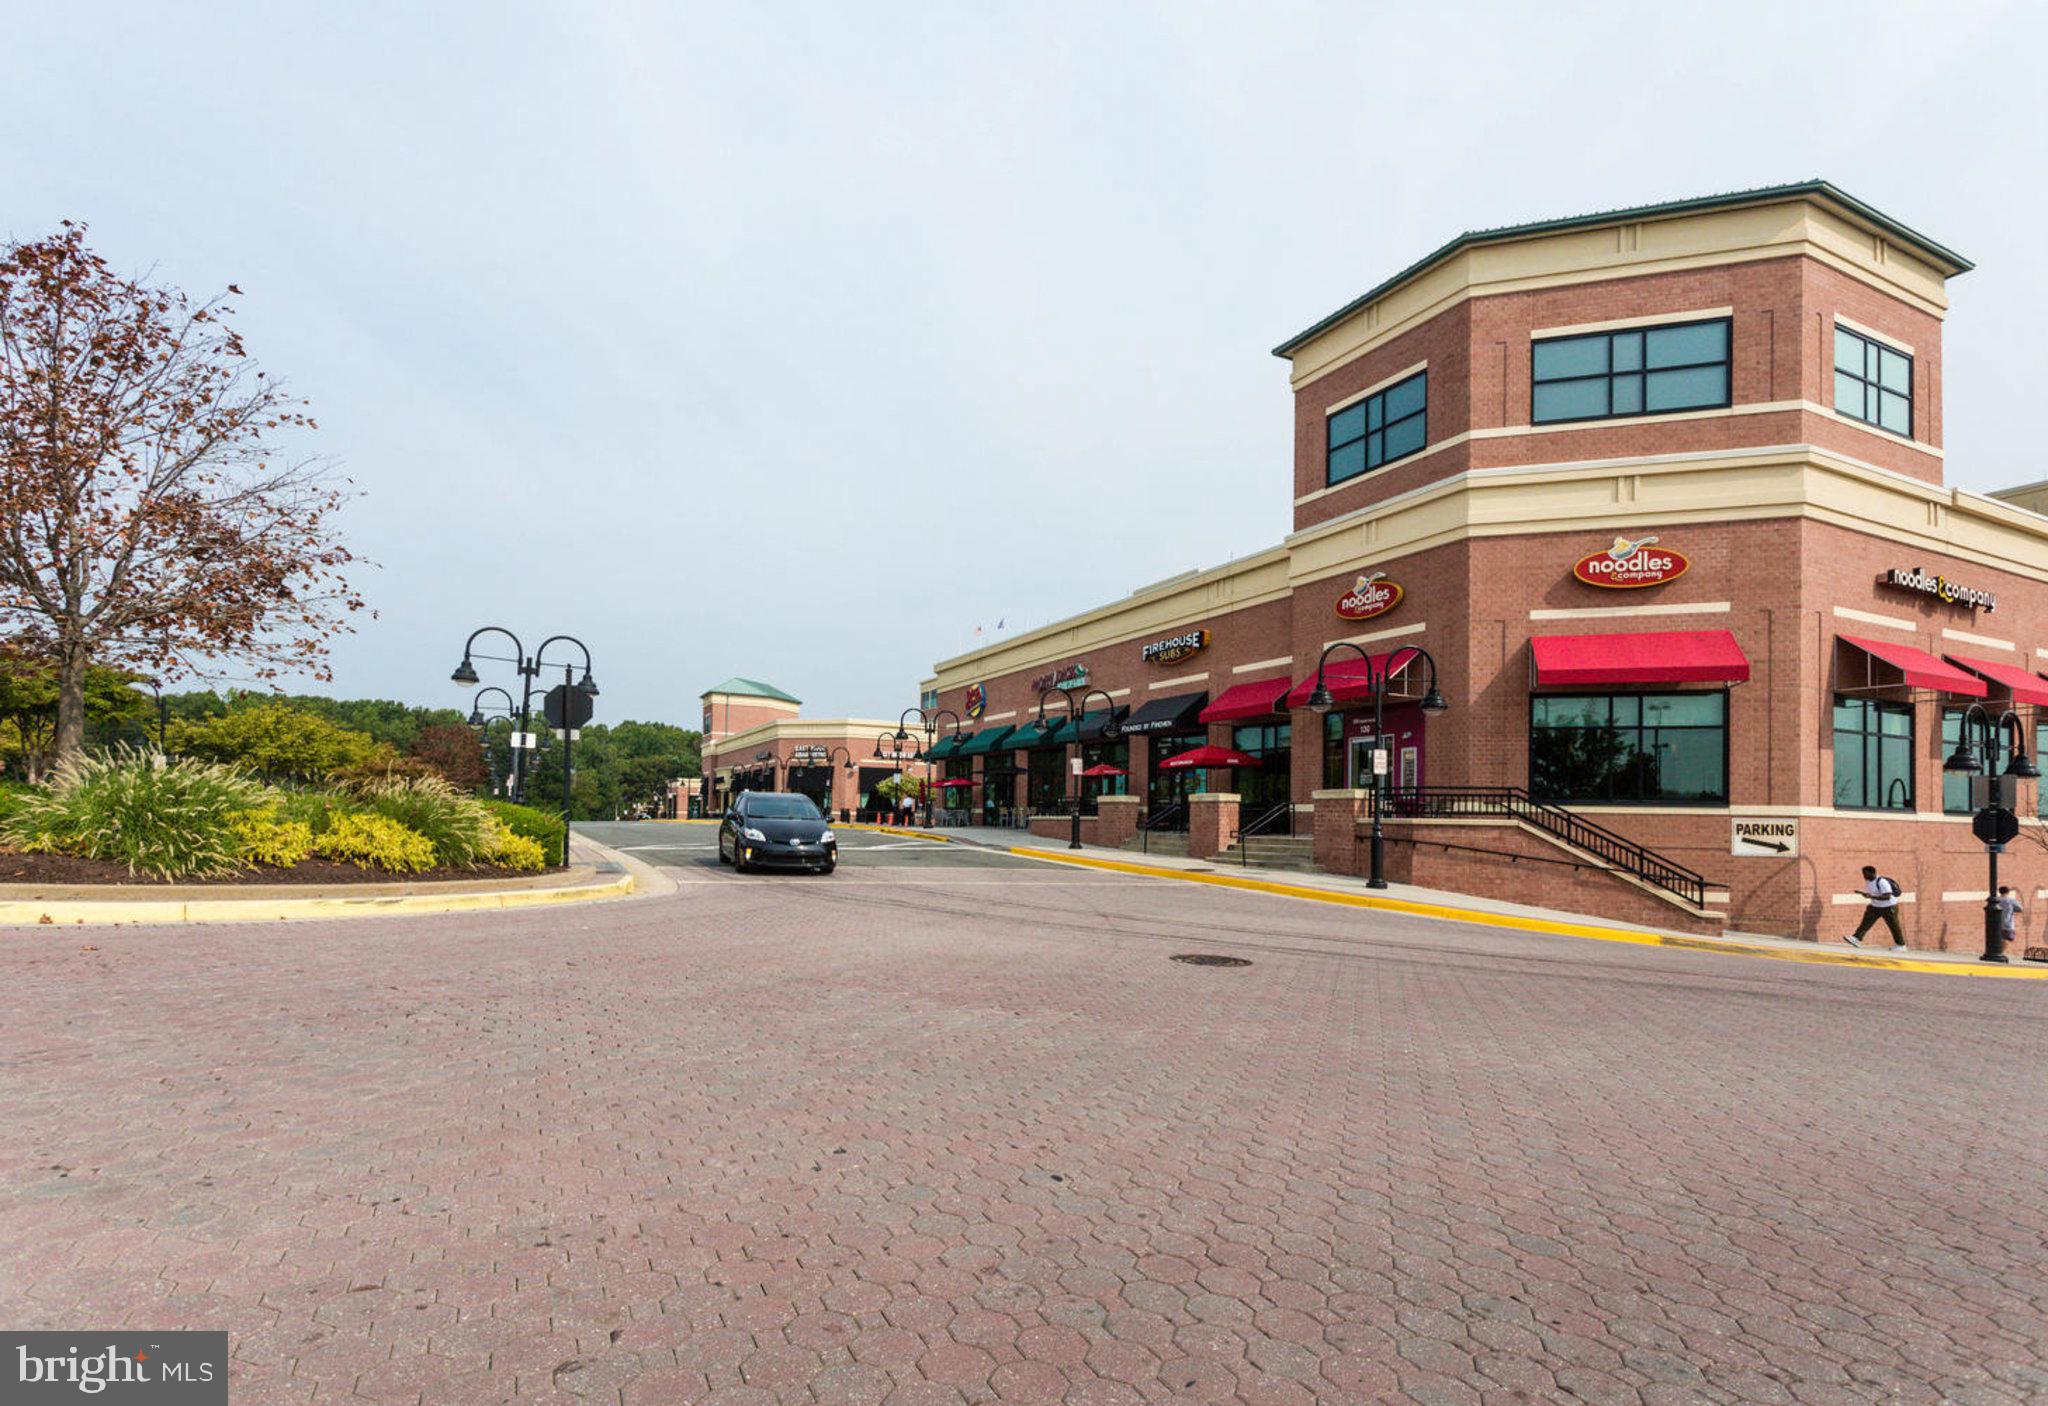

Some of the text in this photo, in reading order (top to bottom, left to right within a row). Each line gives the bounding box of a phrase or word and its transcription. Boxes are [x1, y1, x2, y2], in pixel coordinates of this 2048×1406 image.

[1588, 551, 1673, 574] noodles
[1341, 585, 1390, 610] noodles
[1894, 567, 1938, 594] noodles
[1945, 584, 1997, 613] company
[1141, 631, 1200, 662] FIREHOUSE
[1158, 648, 1181, 661] SUBS
[1735, 823, 1795, 836] PARKING
